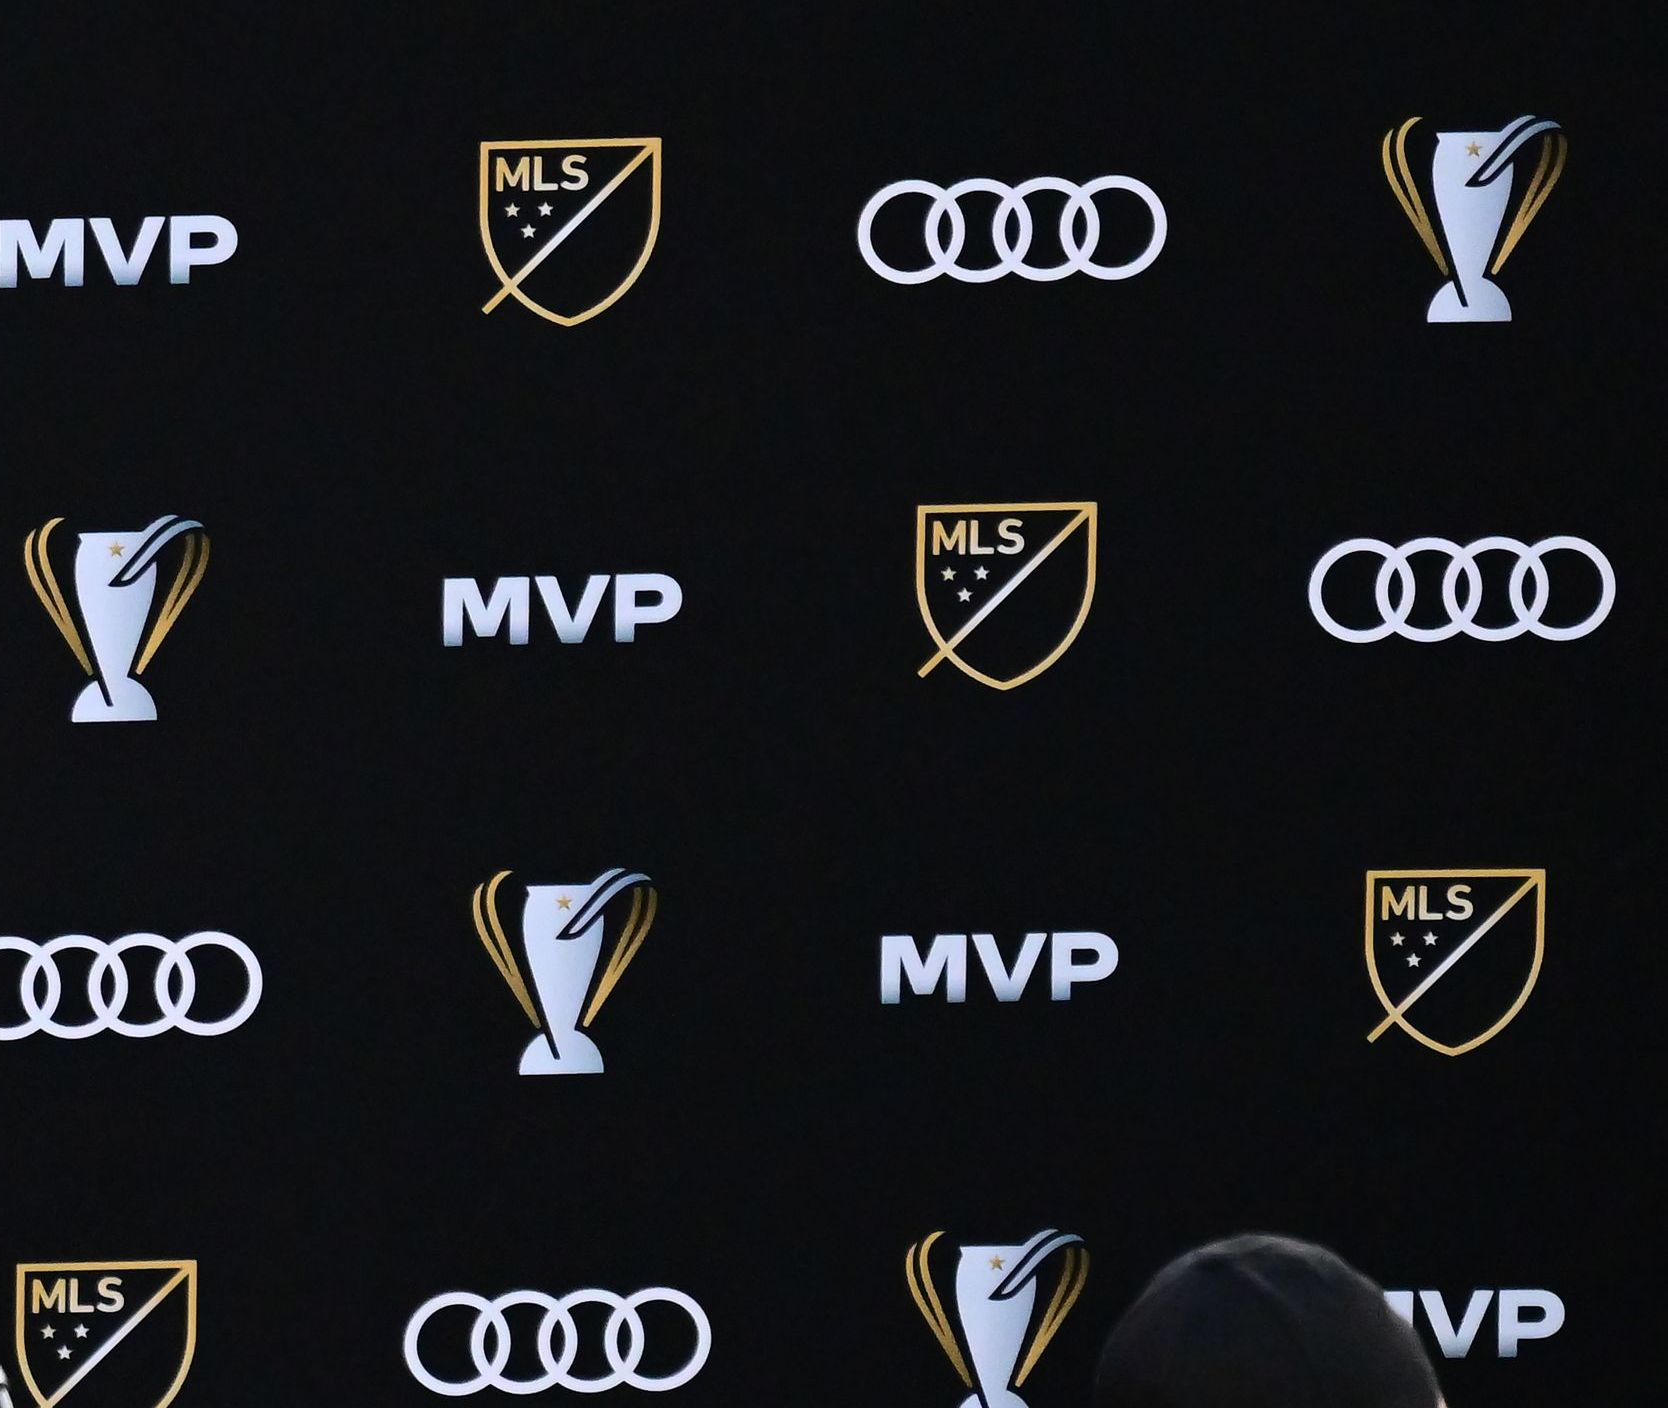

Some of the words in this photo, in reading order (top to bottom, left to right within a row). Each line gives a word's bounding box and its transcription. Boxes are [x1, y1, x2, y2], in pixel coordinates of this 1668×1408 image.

[495, 154, 589, 192] MLS
[932, 518, 1025, 556] MLS
[442, 572, 683, 647] MVP
[1381, 884, 1474, 921] MLS
[880, 931, 1119, 1005] MVP
[31, 1276, 125, 1314] MLS
